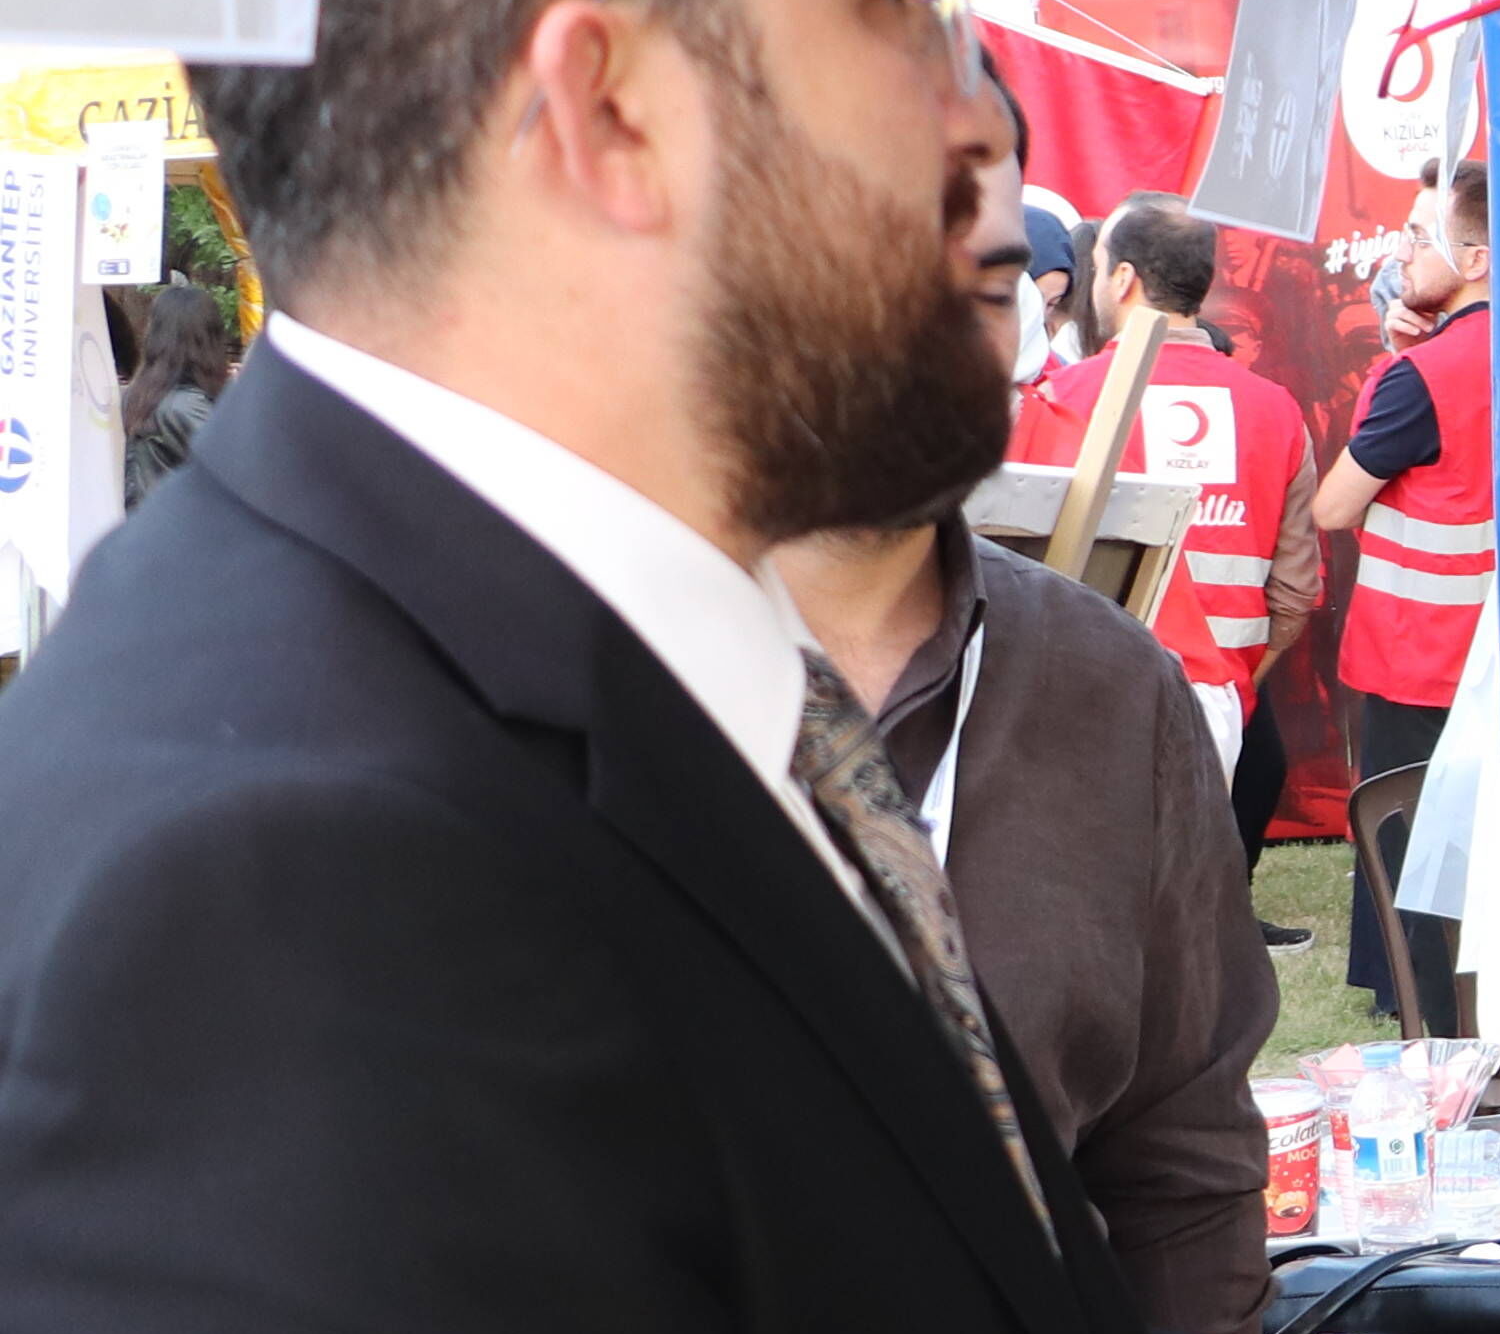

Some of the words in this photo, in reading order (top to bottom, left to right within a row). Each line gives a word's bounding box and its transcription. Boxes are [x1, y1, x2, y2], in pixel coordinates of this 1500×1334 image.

[79, 81, 206, 144] GAZİA
[1383, 124, 1440, 141] KIZILAY
[0, 170, 21, 376] GAZİANTEP
[22, 173, 44, 379] ÜNİVERSİTESİ
[1166, 459, 1209, 469] KIZILAY
